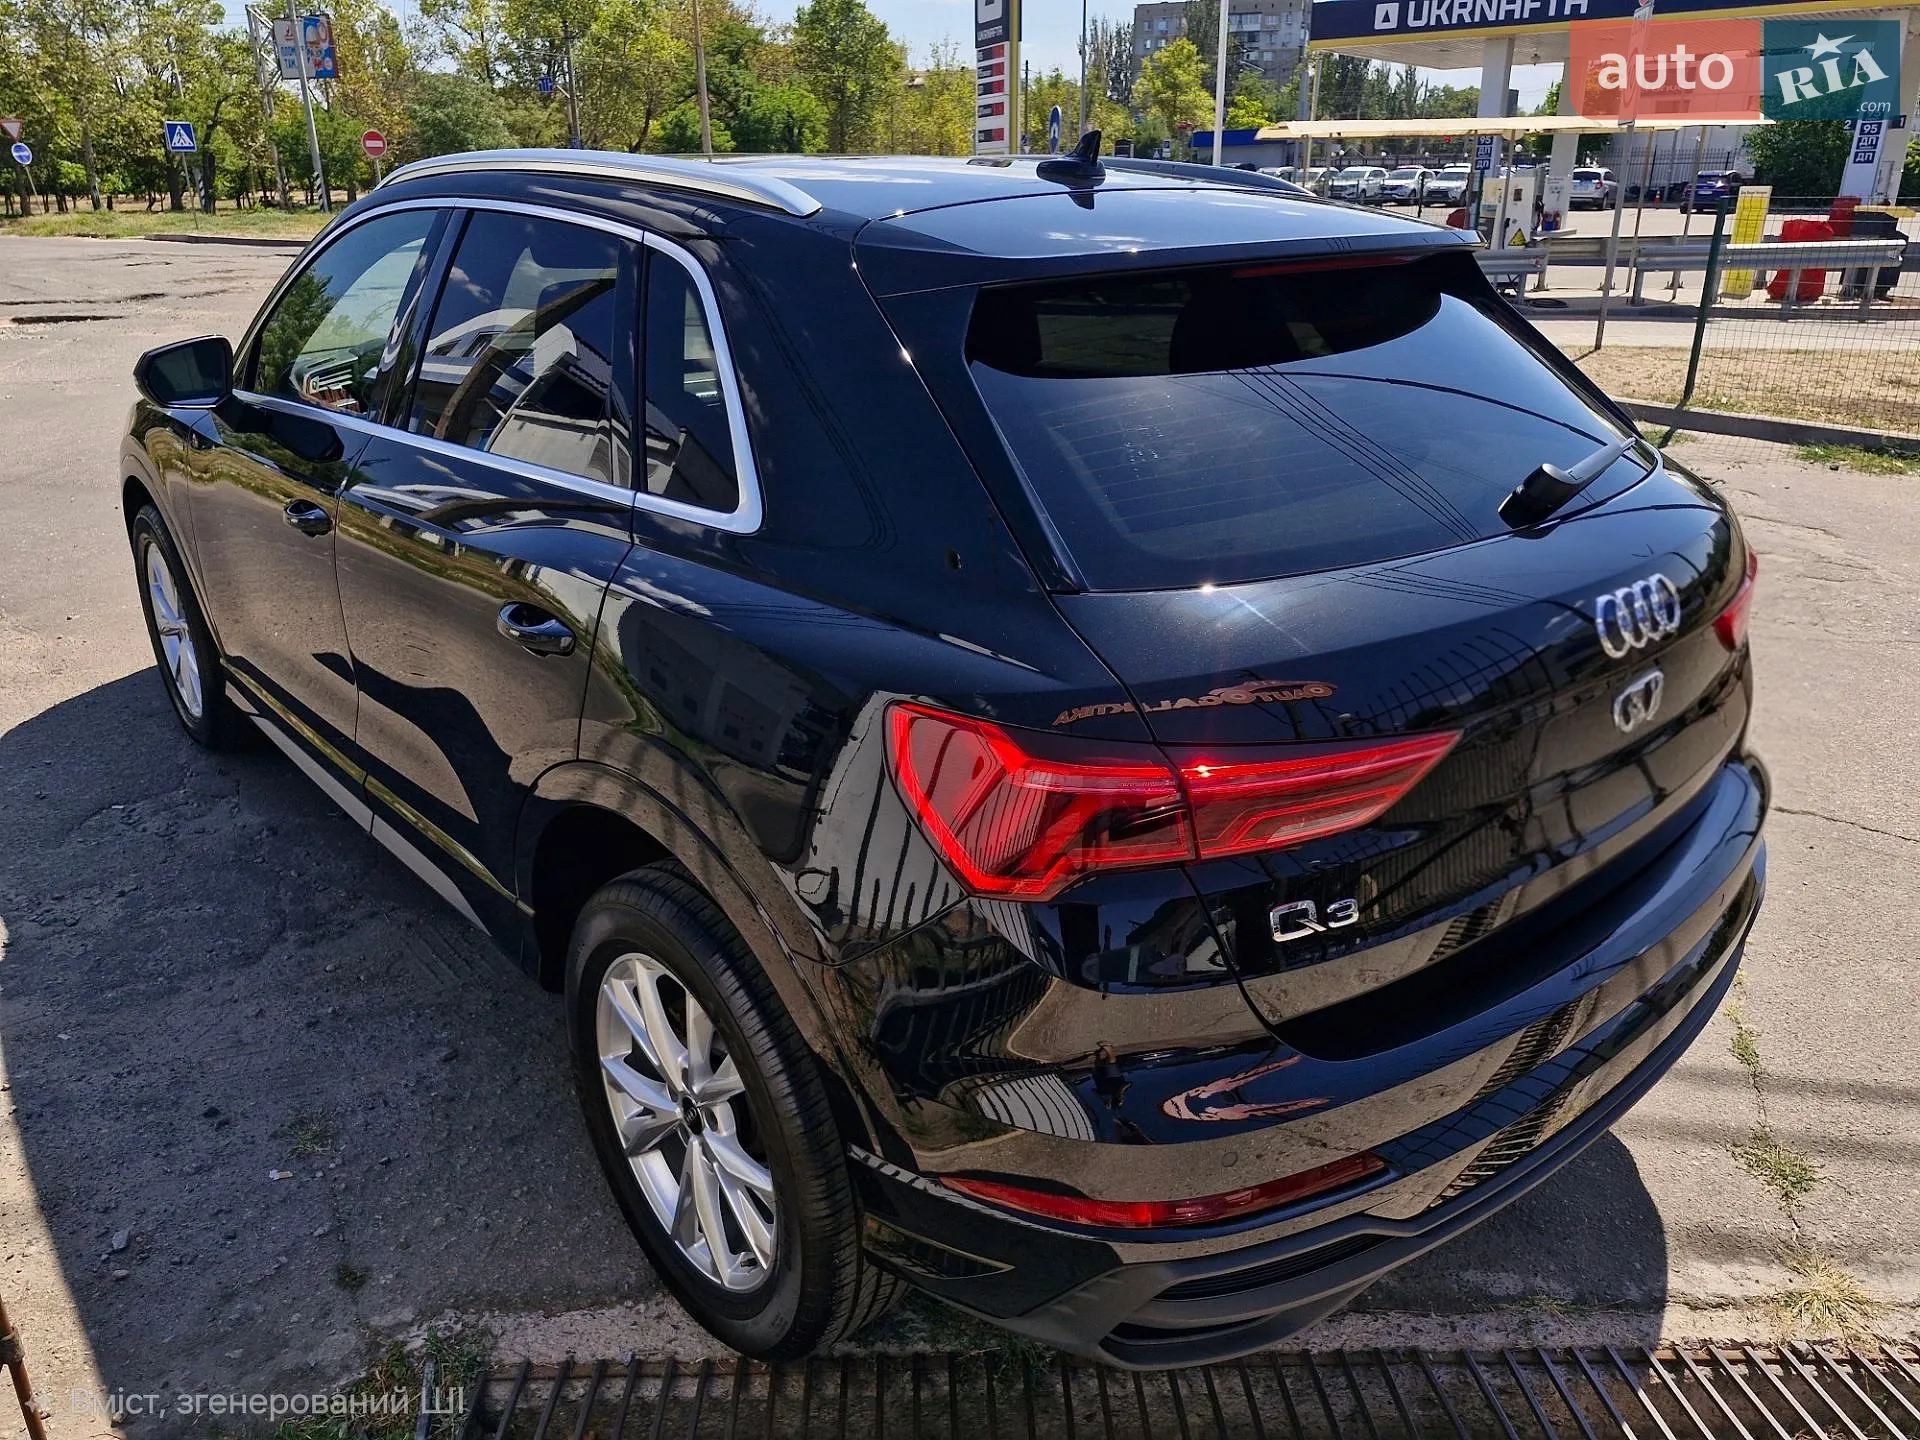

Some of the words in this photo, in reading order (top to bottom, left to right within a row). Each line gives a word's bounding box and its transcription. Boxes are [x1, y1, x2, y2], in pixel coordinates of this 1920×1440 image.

[1864, 124, 1878, 133] 95
[1860, 136, 1876, 146] ДП
[1856, 152, 1873, 161] ДП
[1270, 898, 1359, 943] Q3
